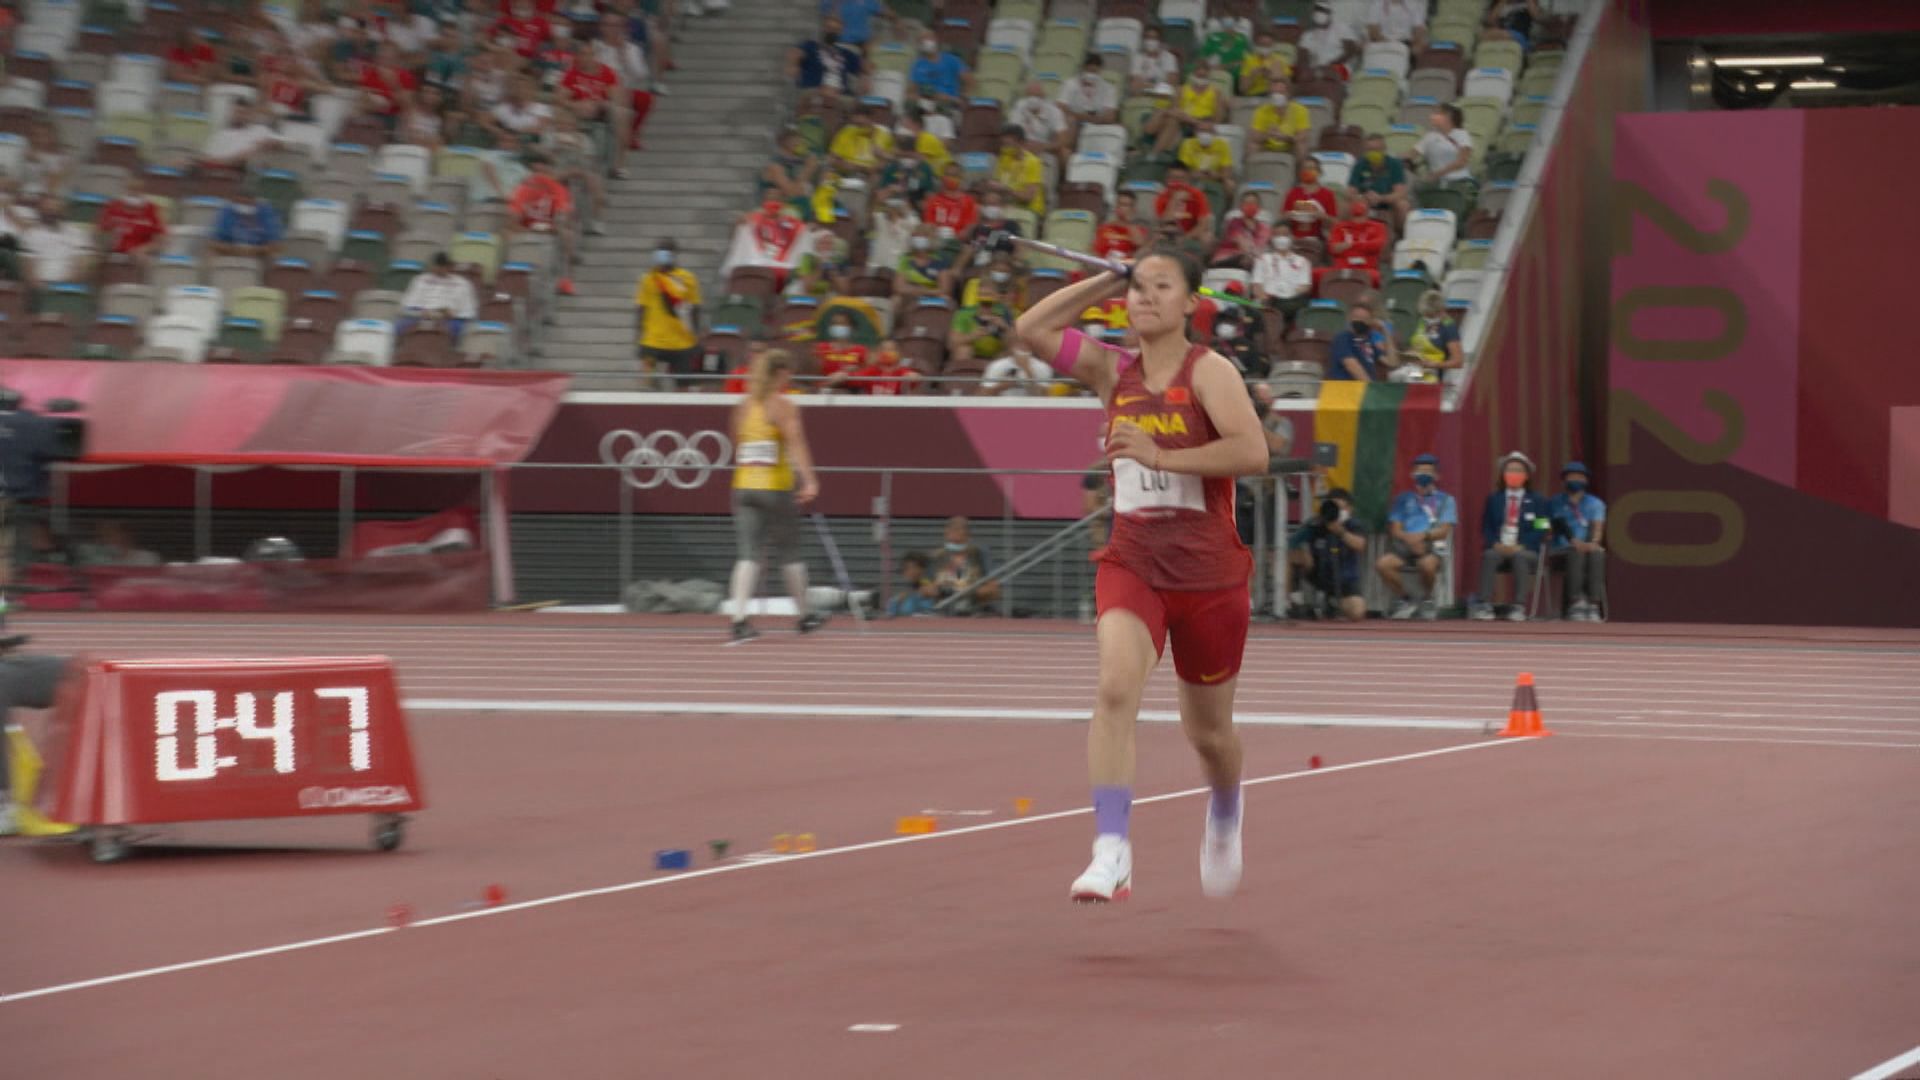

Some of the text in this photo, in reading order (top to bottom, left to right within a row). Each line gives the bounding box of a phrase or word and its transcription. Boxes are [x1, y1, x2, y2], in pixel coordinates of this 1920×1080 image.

[1607, 177, 1751, 566] 2020
[1140, 470, 1169, 492] LIU
[154, 686, 371, 782] 0:47
